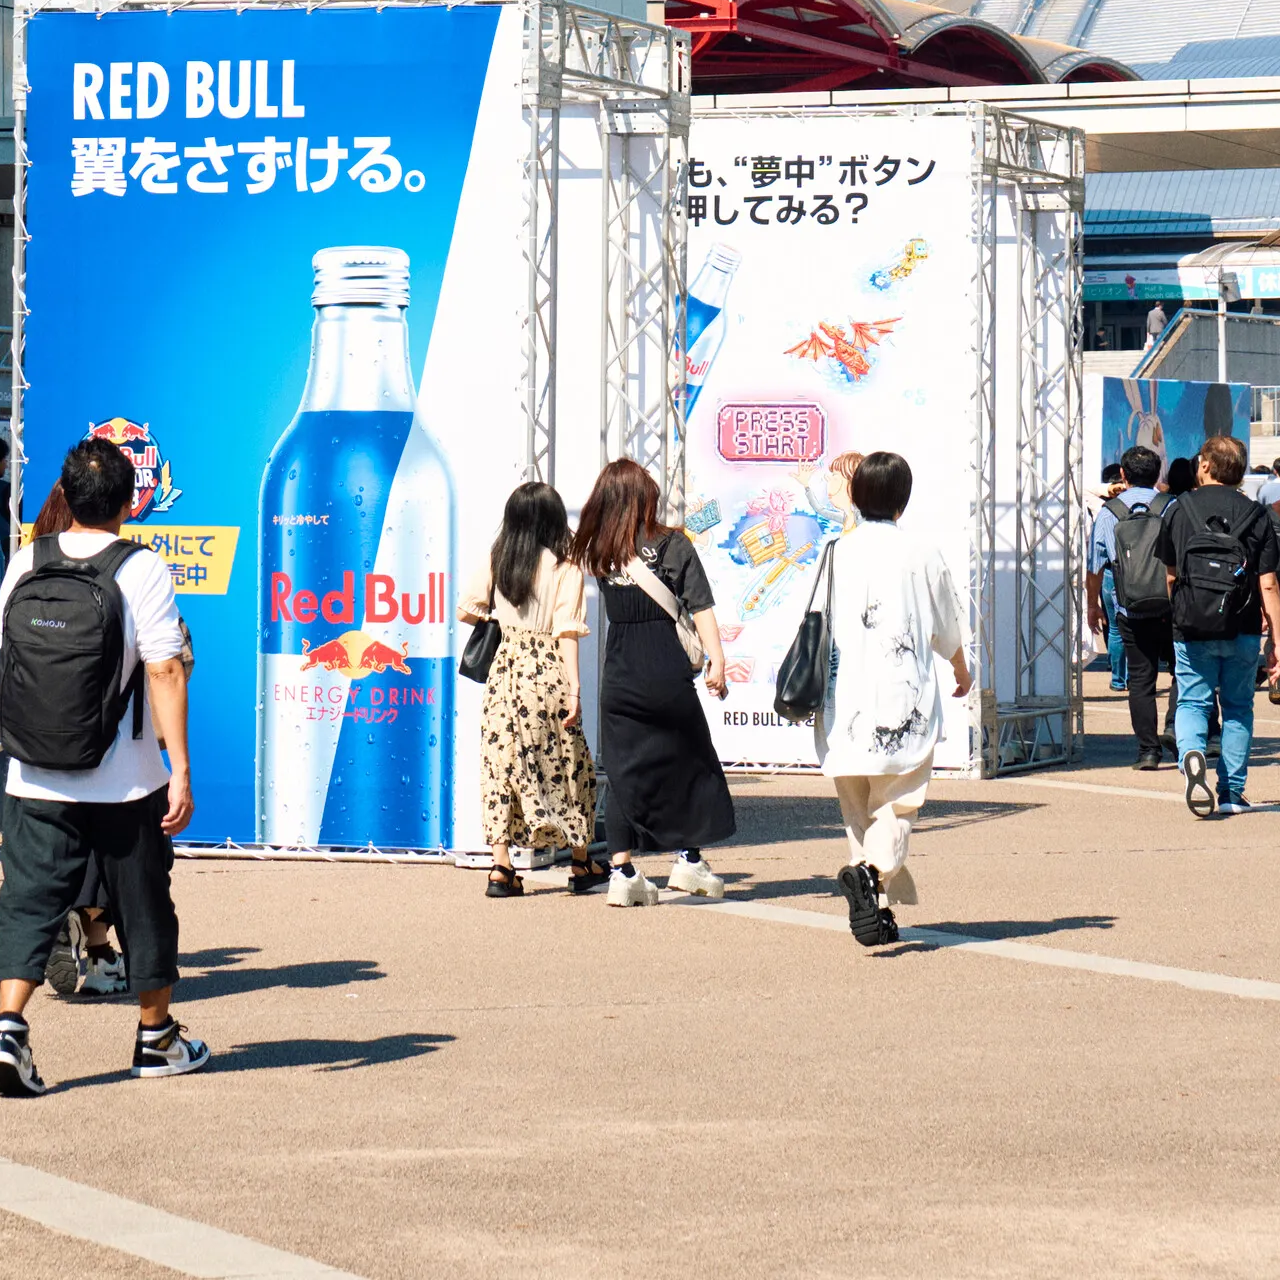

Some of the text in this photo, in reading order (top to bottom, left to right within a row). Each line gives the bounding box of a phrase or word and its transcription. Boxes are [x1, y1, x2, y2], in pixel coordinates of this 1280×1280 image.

[73, 60, 305, 120] RED BULL
[71, 136, 426, 197] 翼をさずける。
[677, 155, 937, 189] も、“夢中”ボタン
[735, 410, 809, 432] PRESS
[735, 433, 809, 455] START
[271, 570, 355, 624] Red
[365, 572, 445, 625] Bull
[31, 618, 66, 628] KOMOJU
[274, 684, 437, 706] ENERGY DRINK
[306, 706, 399, 723] エナジードリンク
[724, 711, 749, 726] RED
[753, 712, 783, 727] BULL
